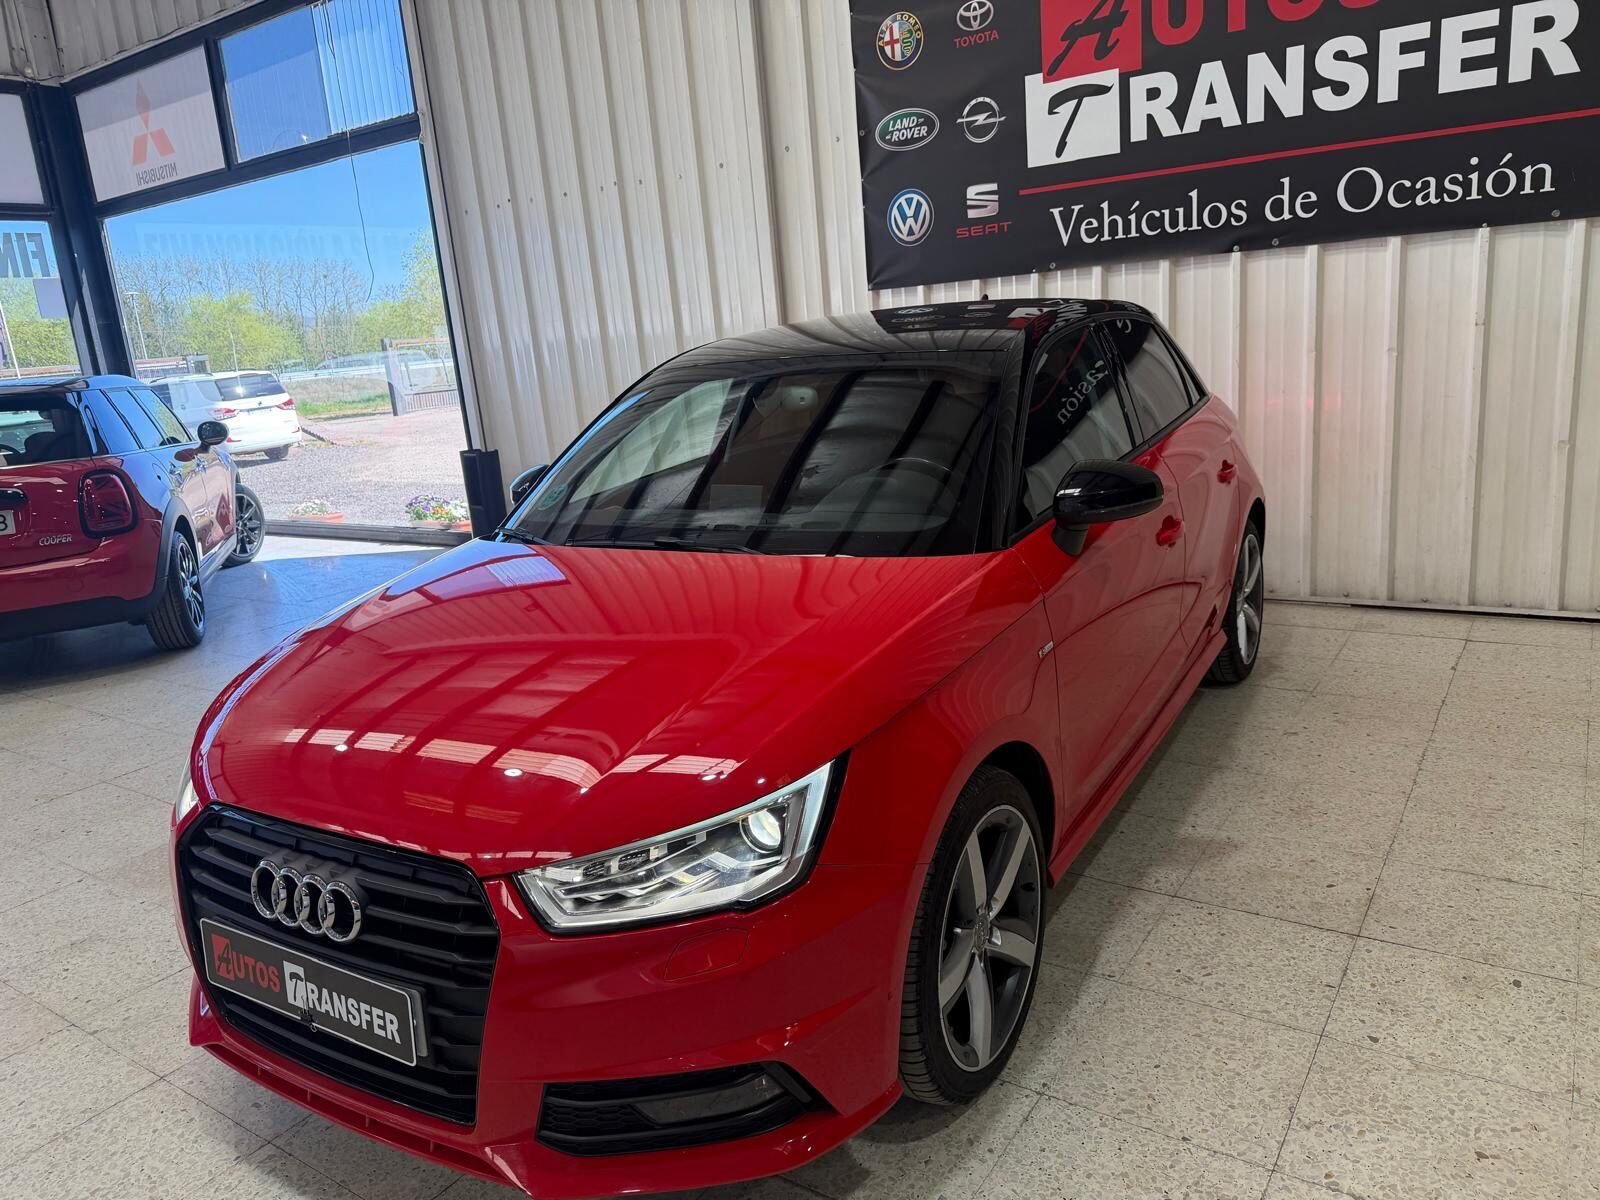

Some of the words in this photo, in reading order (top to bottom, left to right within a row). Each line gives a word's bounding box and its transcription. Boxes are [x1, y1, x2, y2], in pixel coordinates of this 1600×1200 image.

[896, 14, 922, 40] ROMEO
[953, 30, 999, 49] TOYOTA
[1024, 0, 1581, 167] TRANSFER
[888, 116, 918, 132] LAND
[891, 126, 928, 142] ROVER
[1049, 188, 1248, 247] Vehículos
[1264, 176, 1318, 223] de
[1336, 152, 1556, 213] Ocasión
[956, 221, 1012, 239] SEAT
[39, 533, 73, 546] COOPER
[211, 934, 281, 993] AUTOS
[283, 960, 401, 1044] TRANSFER
